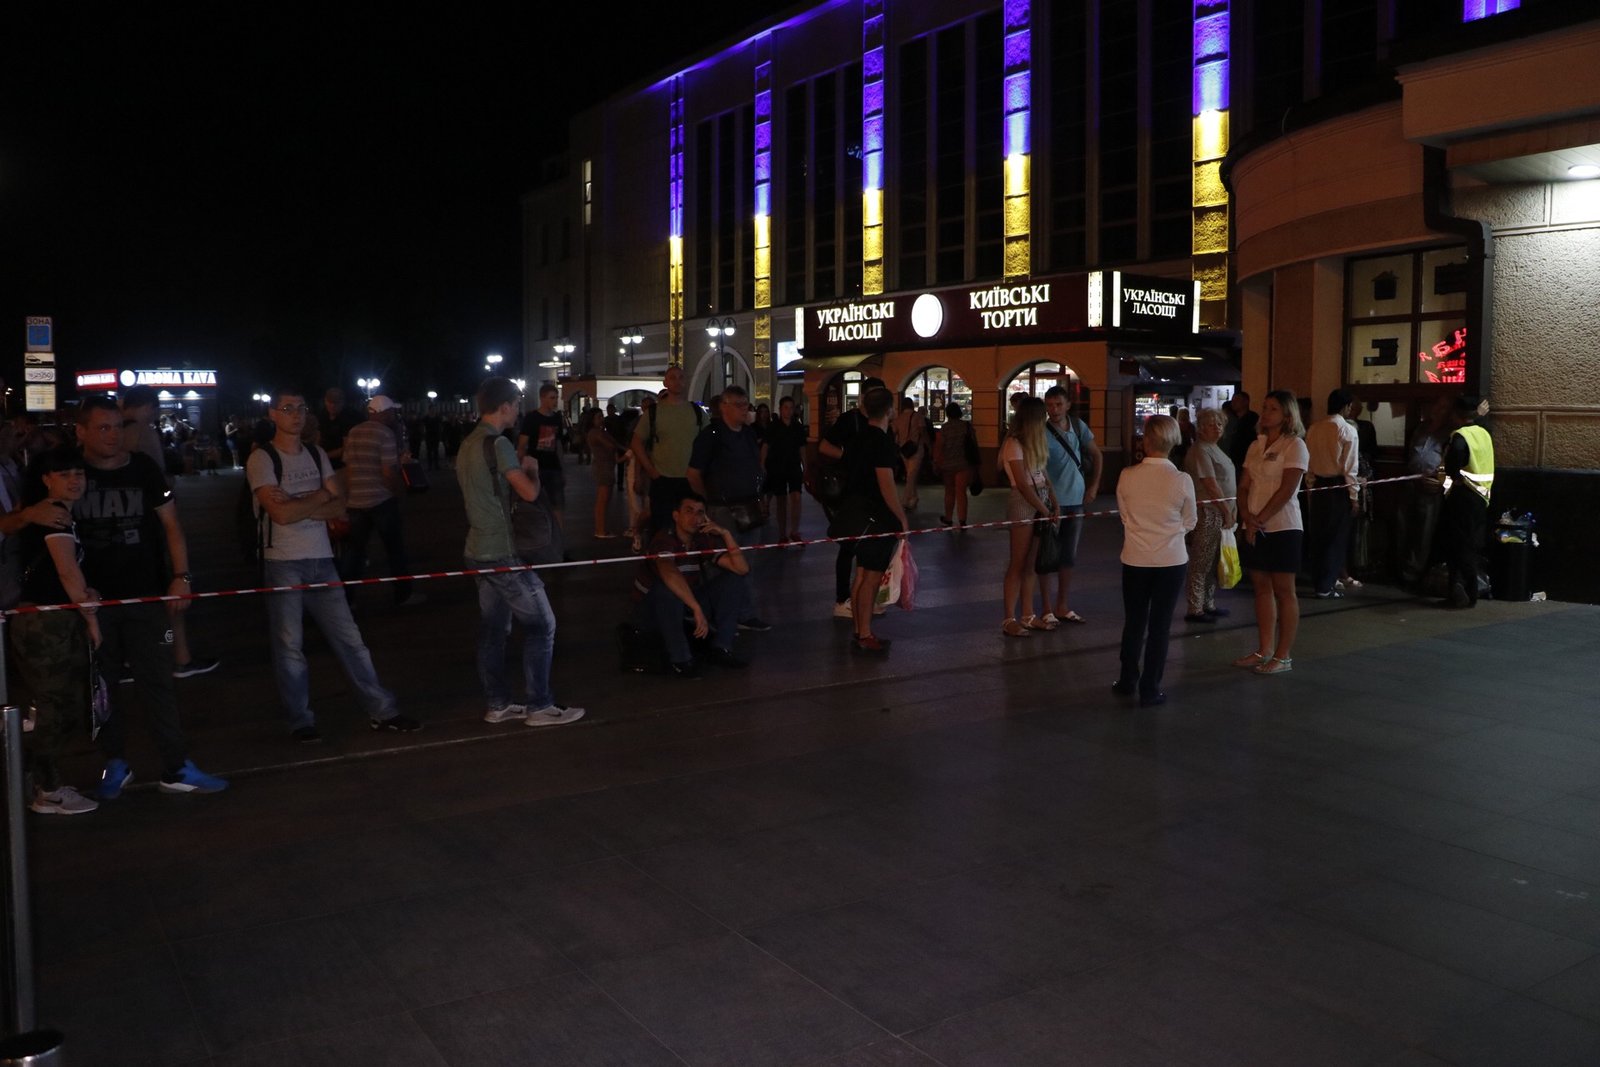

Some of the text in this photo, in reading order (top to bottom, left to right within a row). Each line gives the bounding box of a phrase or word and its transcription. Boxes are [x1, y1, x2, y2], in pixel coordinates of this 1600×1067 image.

[969, 283, 1050, 309] КИЇВСЬКІ
[1123, 288, 1186, 306] УКРАЇНСЬКІ
[816, 301, 895, 328] УКРАЇНСЬКІ
[980, 307, 1038, 330] ТОРТИ
[1132, 302, 1177, 319] ЛАСОЩІ
[828, 321, 883, 342] ЛАСОЩІ
